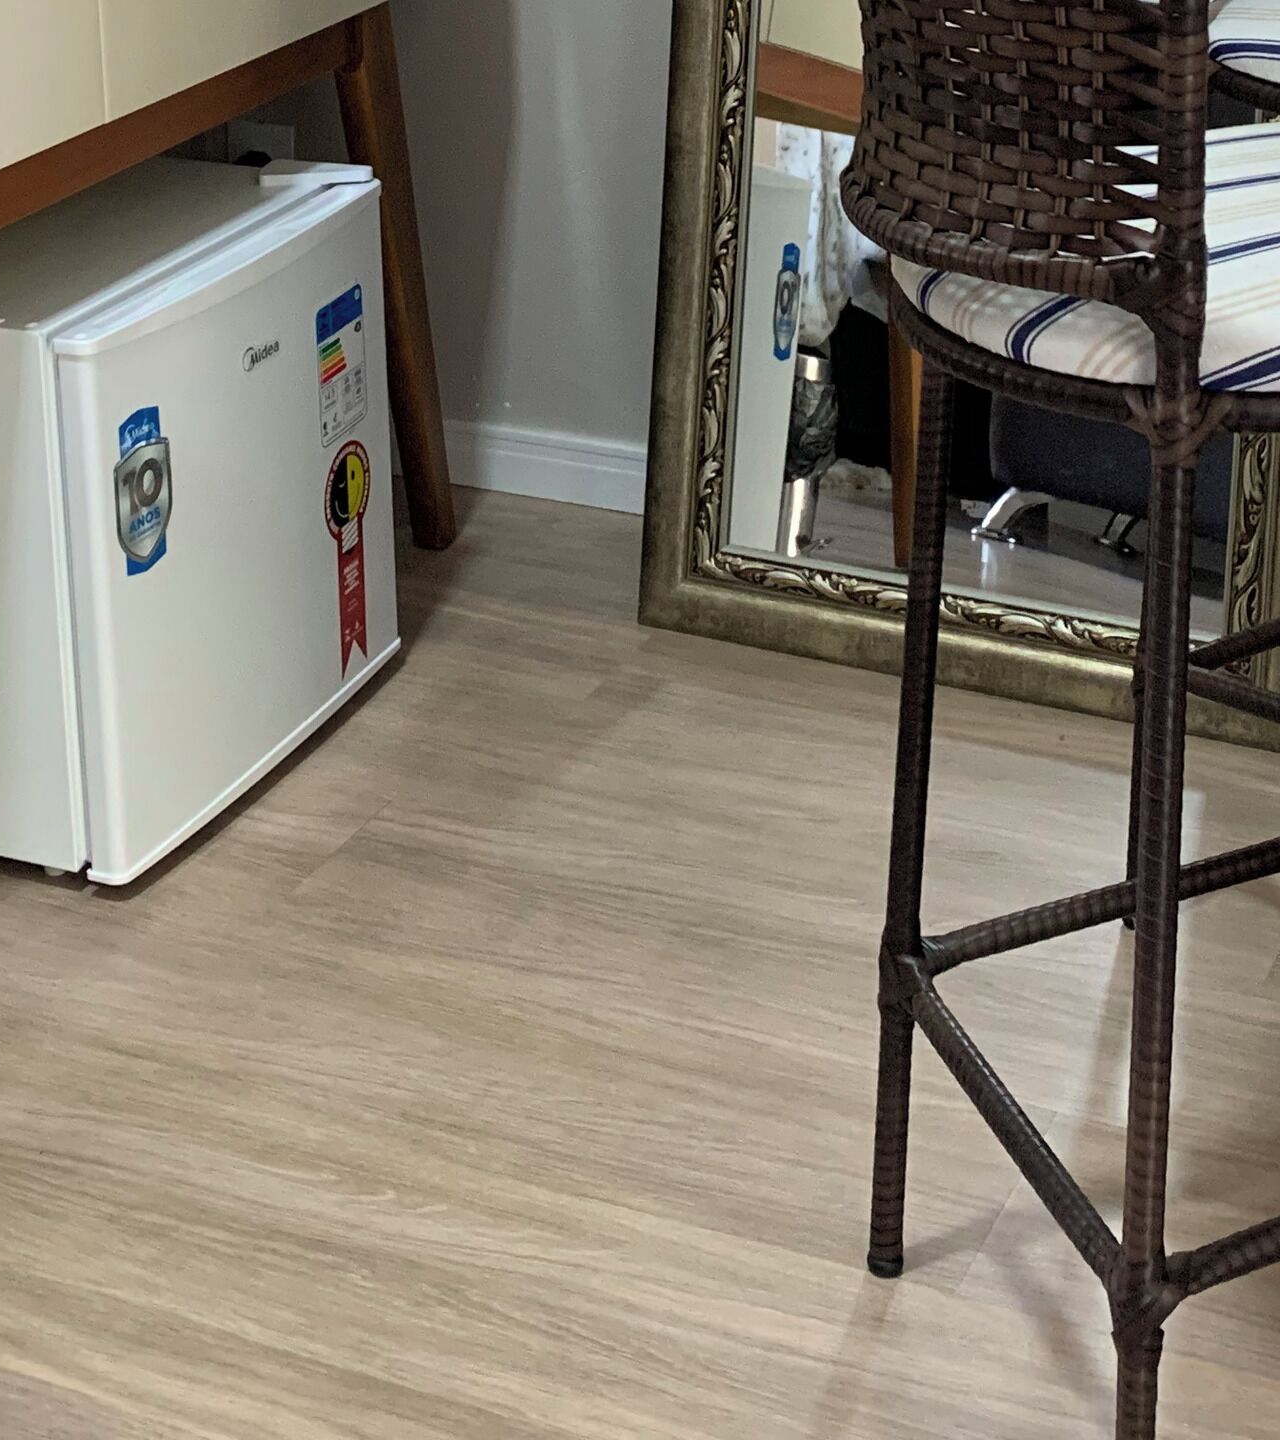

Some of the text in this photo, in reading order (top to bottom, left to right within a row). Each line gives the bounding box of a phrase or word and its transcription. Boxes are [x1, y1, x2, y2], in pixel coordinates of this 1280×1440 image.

[242, 340, 281, 372] Midea
[123, 458, 163, 516] 10
[128, 506, 162, 534] ANOS
